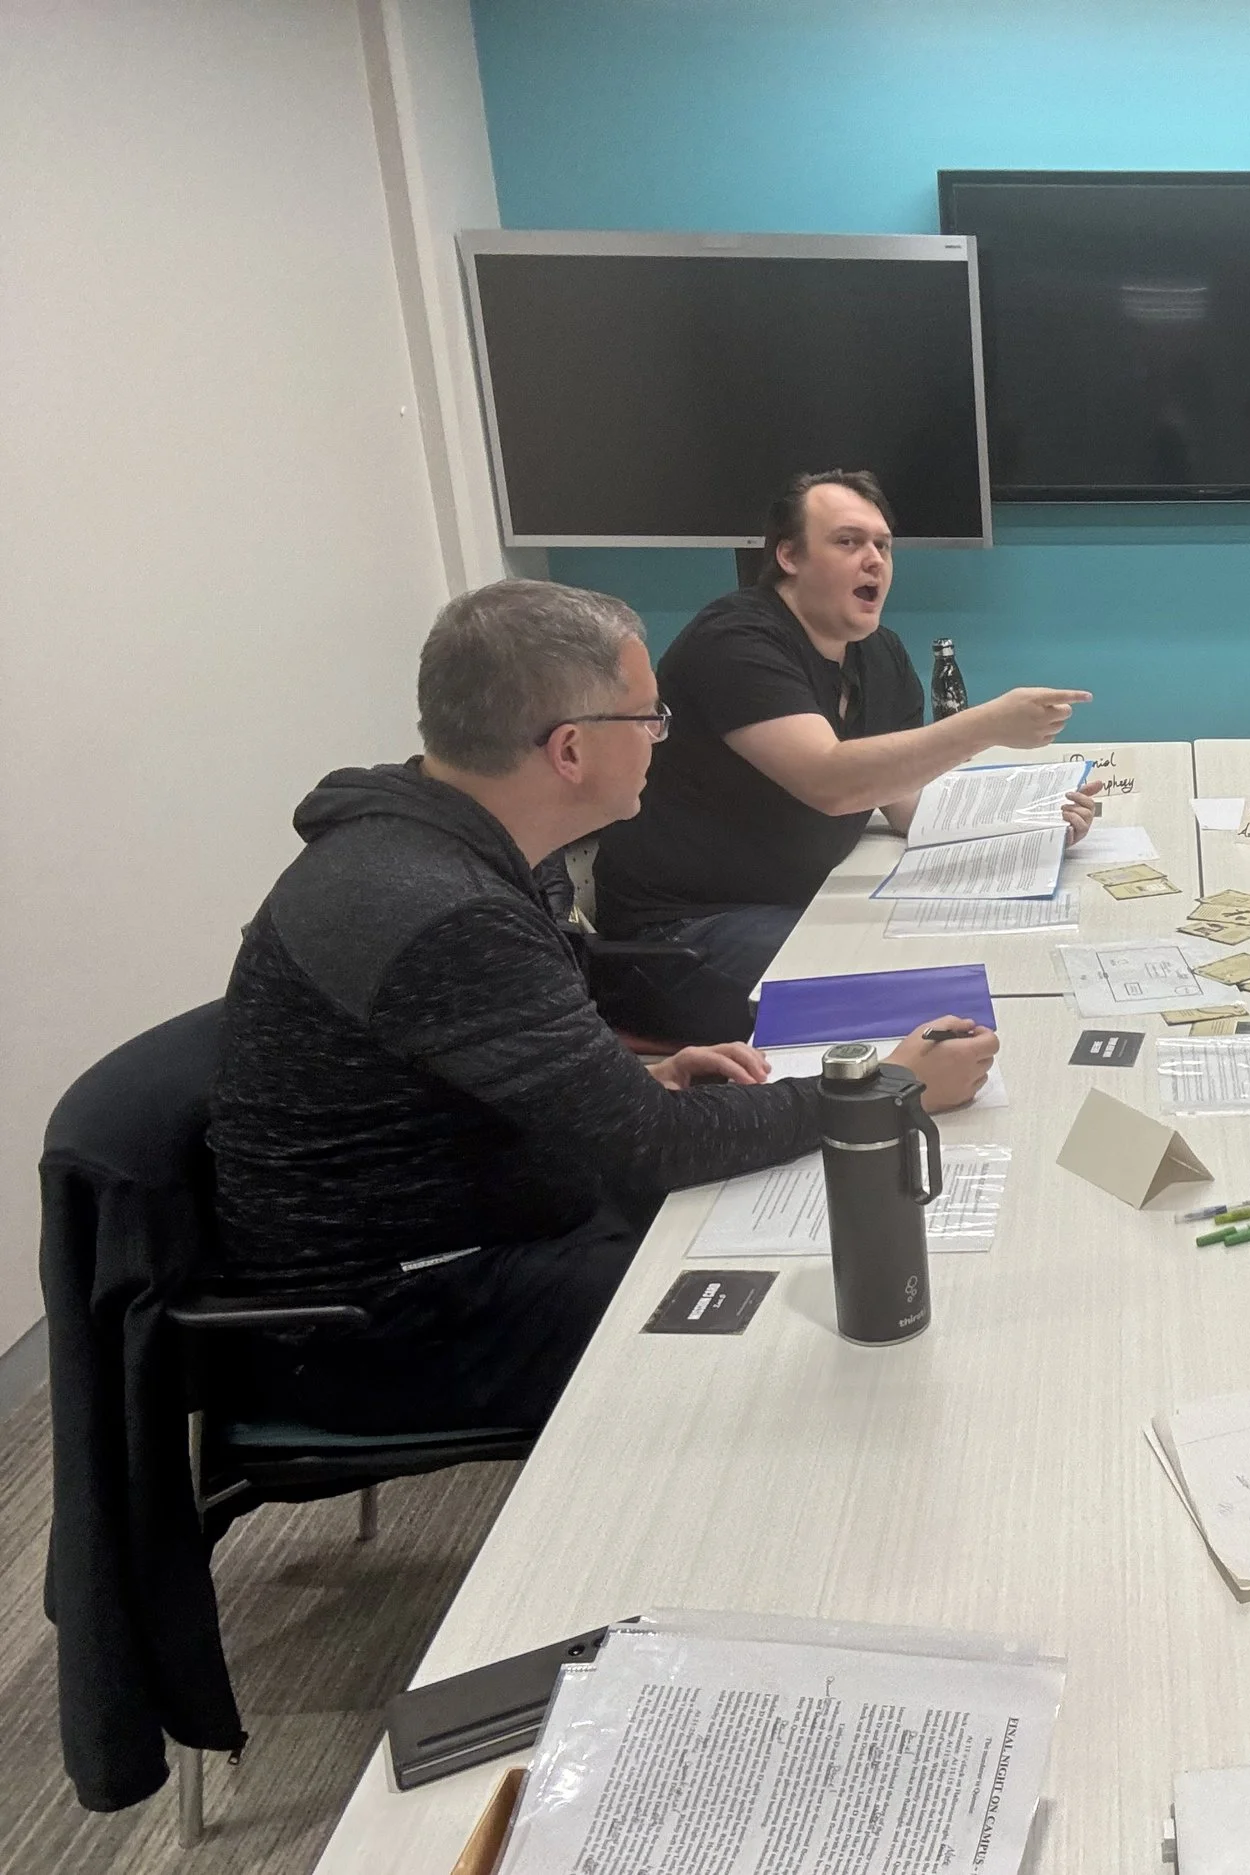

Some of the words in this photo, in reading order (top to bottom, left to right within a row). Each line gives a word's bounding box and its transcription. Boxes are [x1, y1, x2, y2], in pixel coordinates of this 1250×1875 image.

[1001, 1717, 1019, 1751] FINAL
[991, 1754, 1010, 1793] NIGHT
[986, 1795, 1001, 1812] ON
[973, 1815, 996, 1864] CAMPUS
